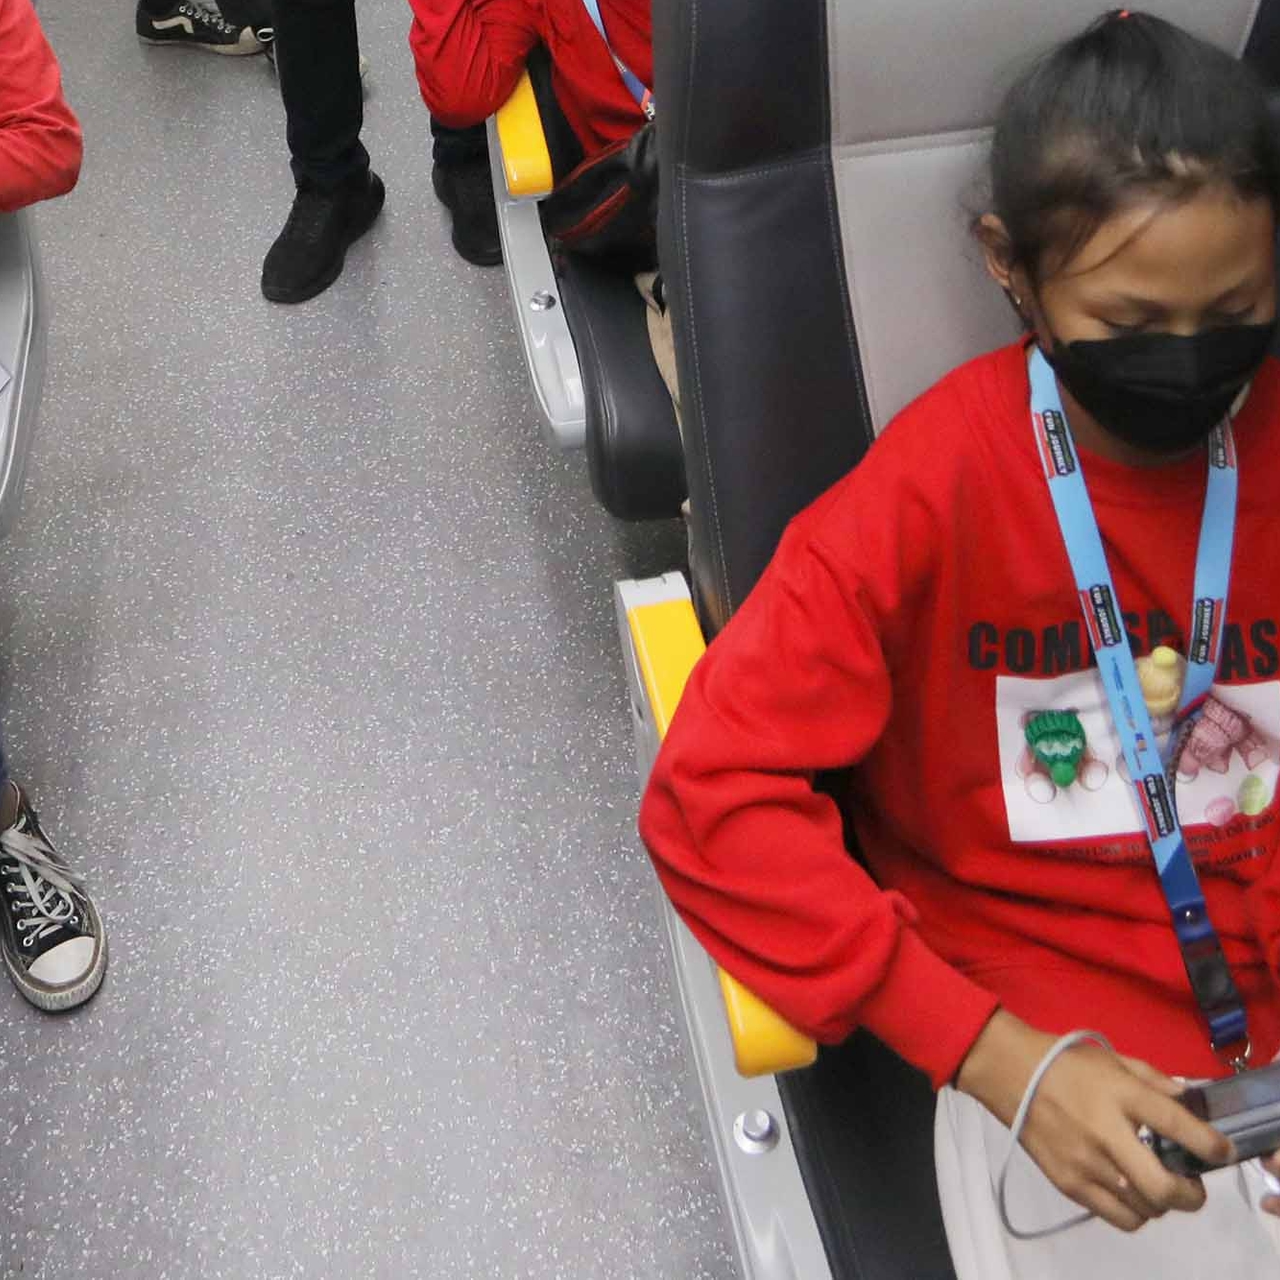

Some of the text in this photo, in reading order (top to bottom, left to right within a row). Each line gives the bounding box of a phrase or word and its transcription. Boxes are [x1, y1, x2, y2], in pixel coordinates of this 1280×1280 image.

[1044, 411, 1067, 474] FUN JOURNEY
[1093, 587, 1114, 644] FUN JOURNEY
[1198, 600, 1212, 662] FUN JOURNEY
[1147, 776, 1168, 834] FUN JOURNEY
